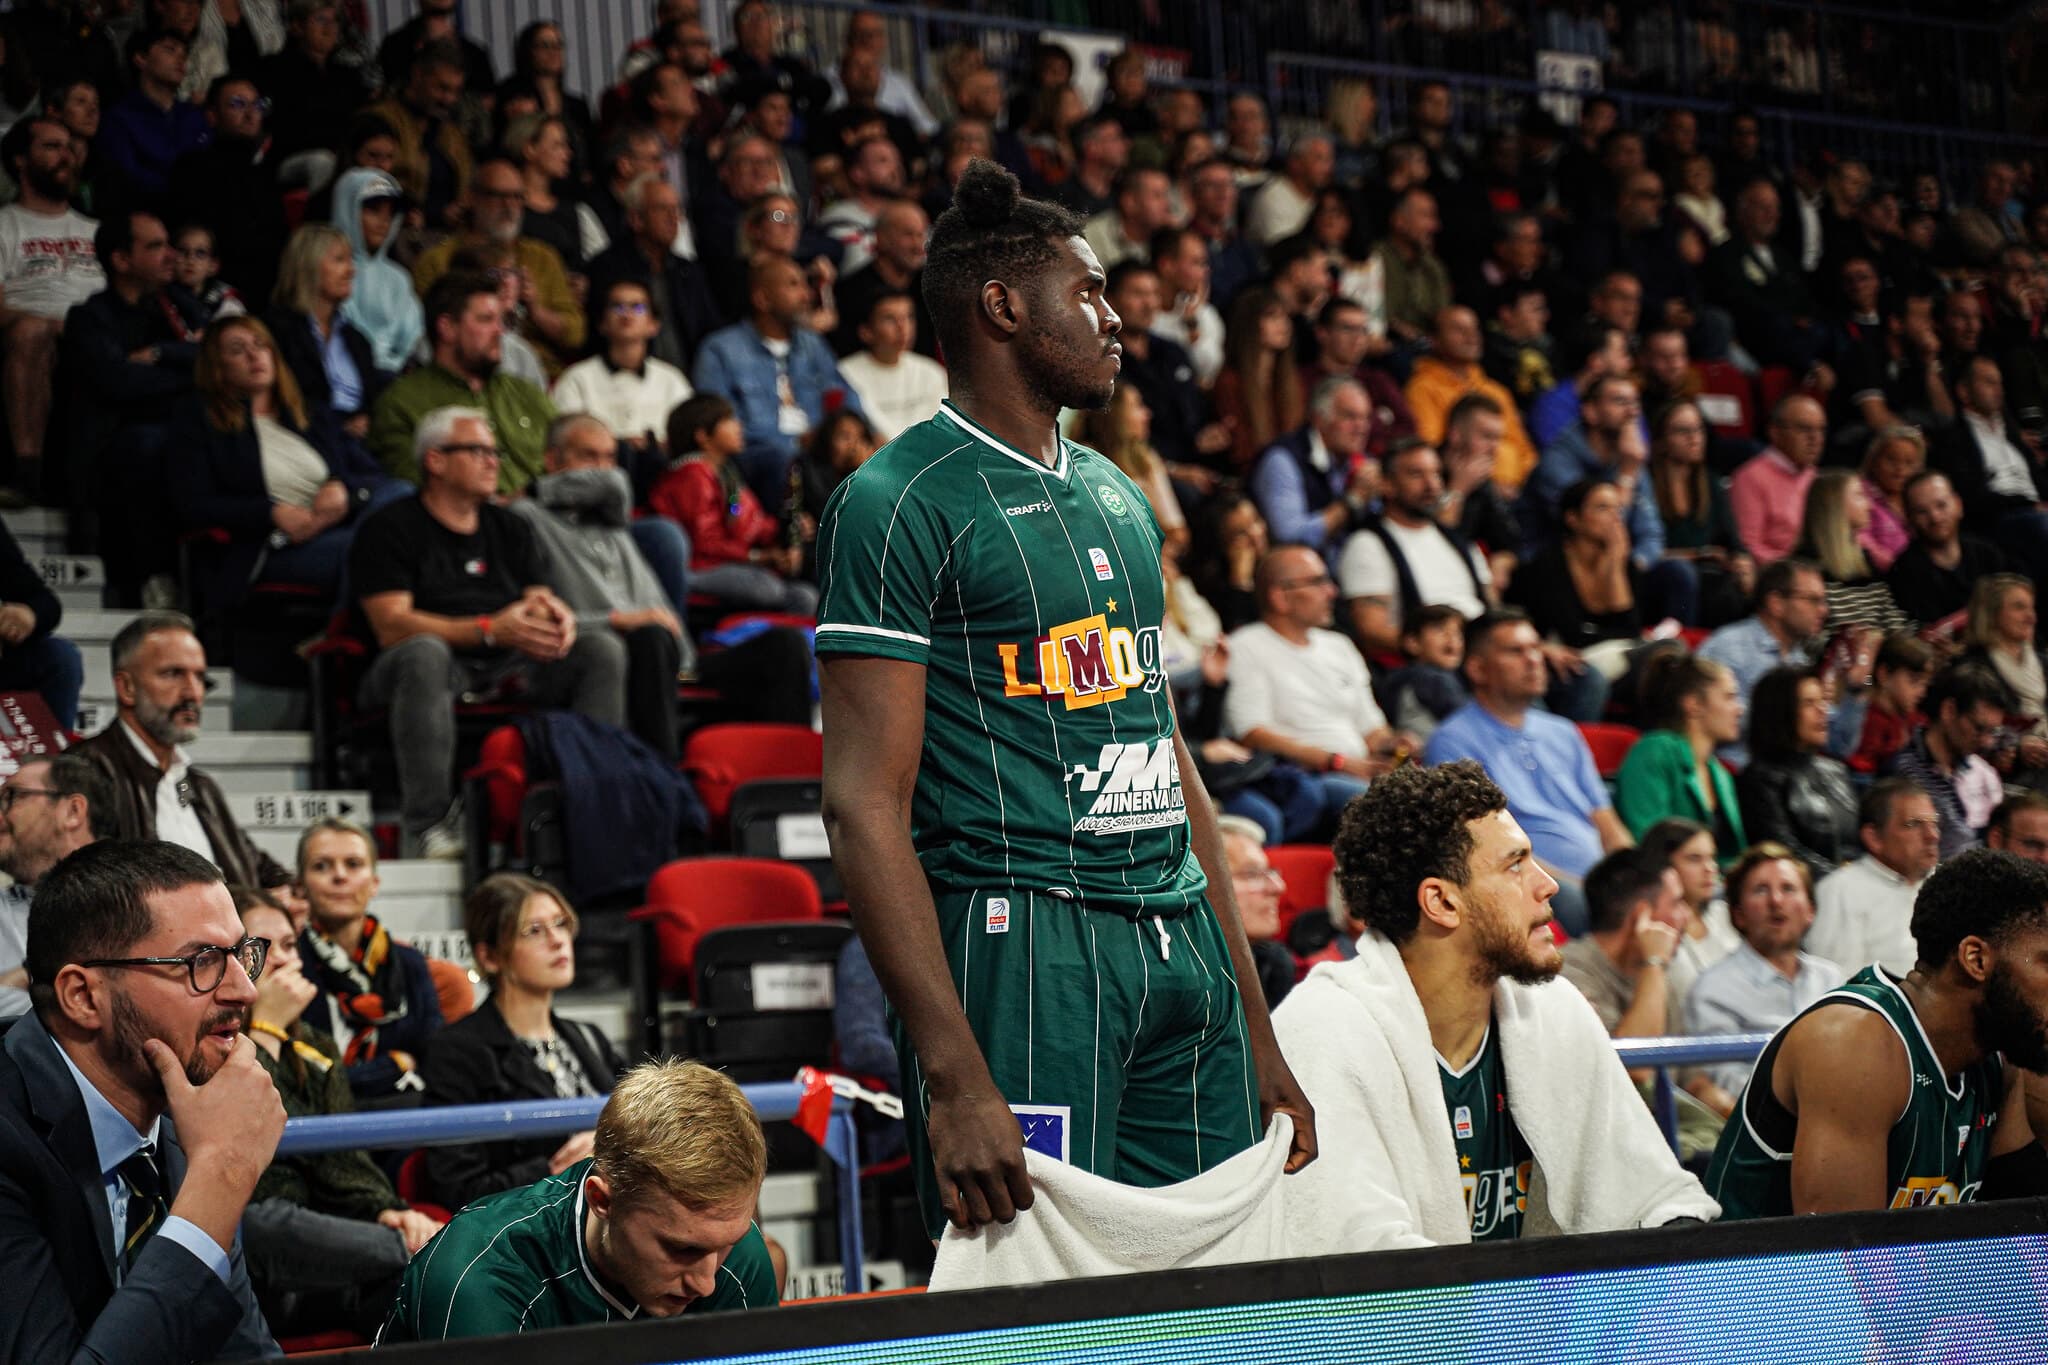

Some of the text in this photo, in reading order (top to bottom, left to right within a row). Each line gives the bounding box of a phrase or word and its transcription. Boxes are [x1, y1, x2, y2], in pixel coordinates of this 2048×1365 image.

[1006, 502, 1042, 516] CRAFT
[1088, 789, 1170, 815] MINERVA
[1074, 816, 1112, 831] NOUS
